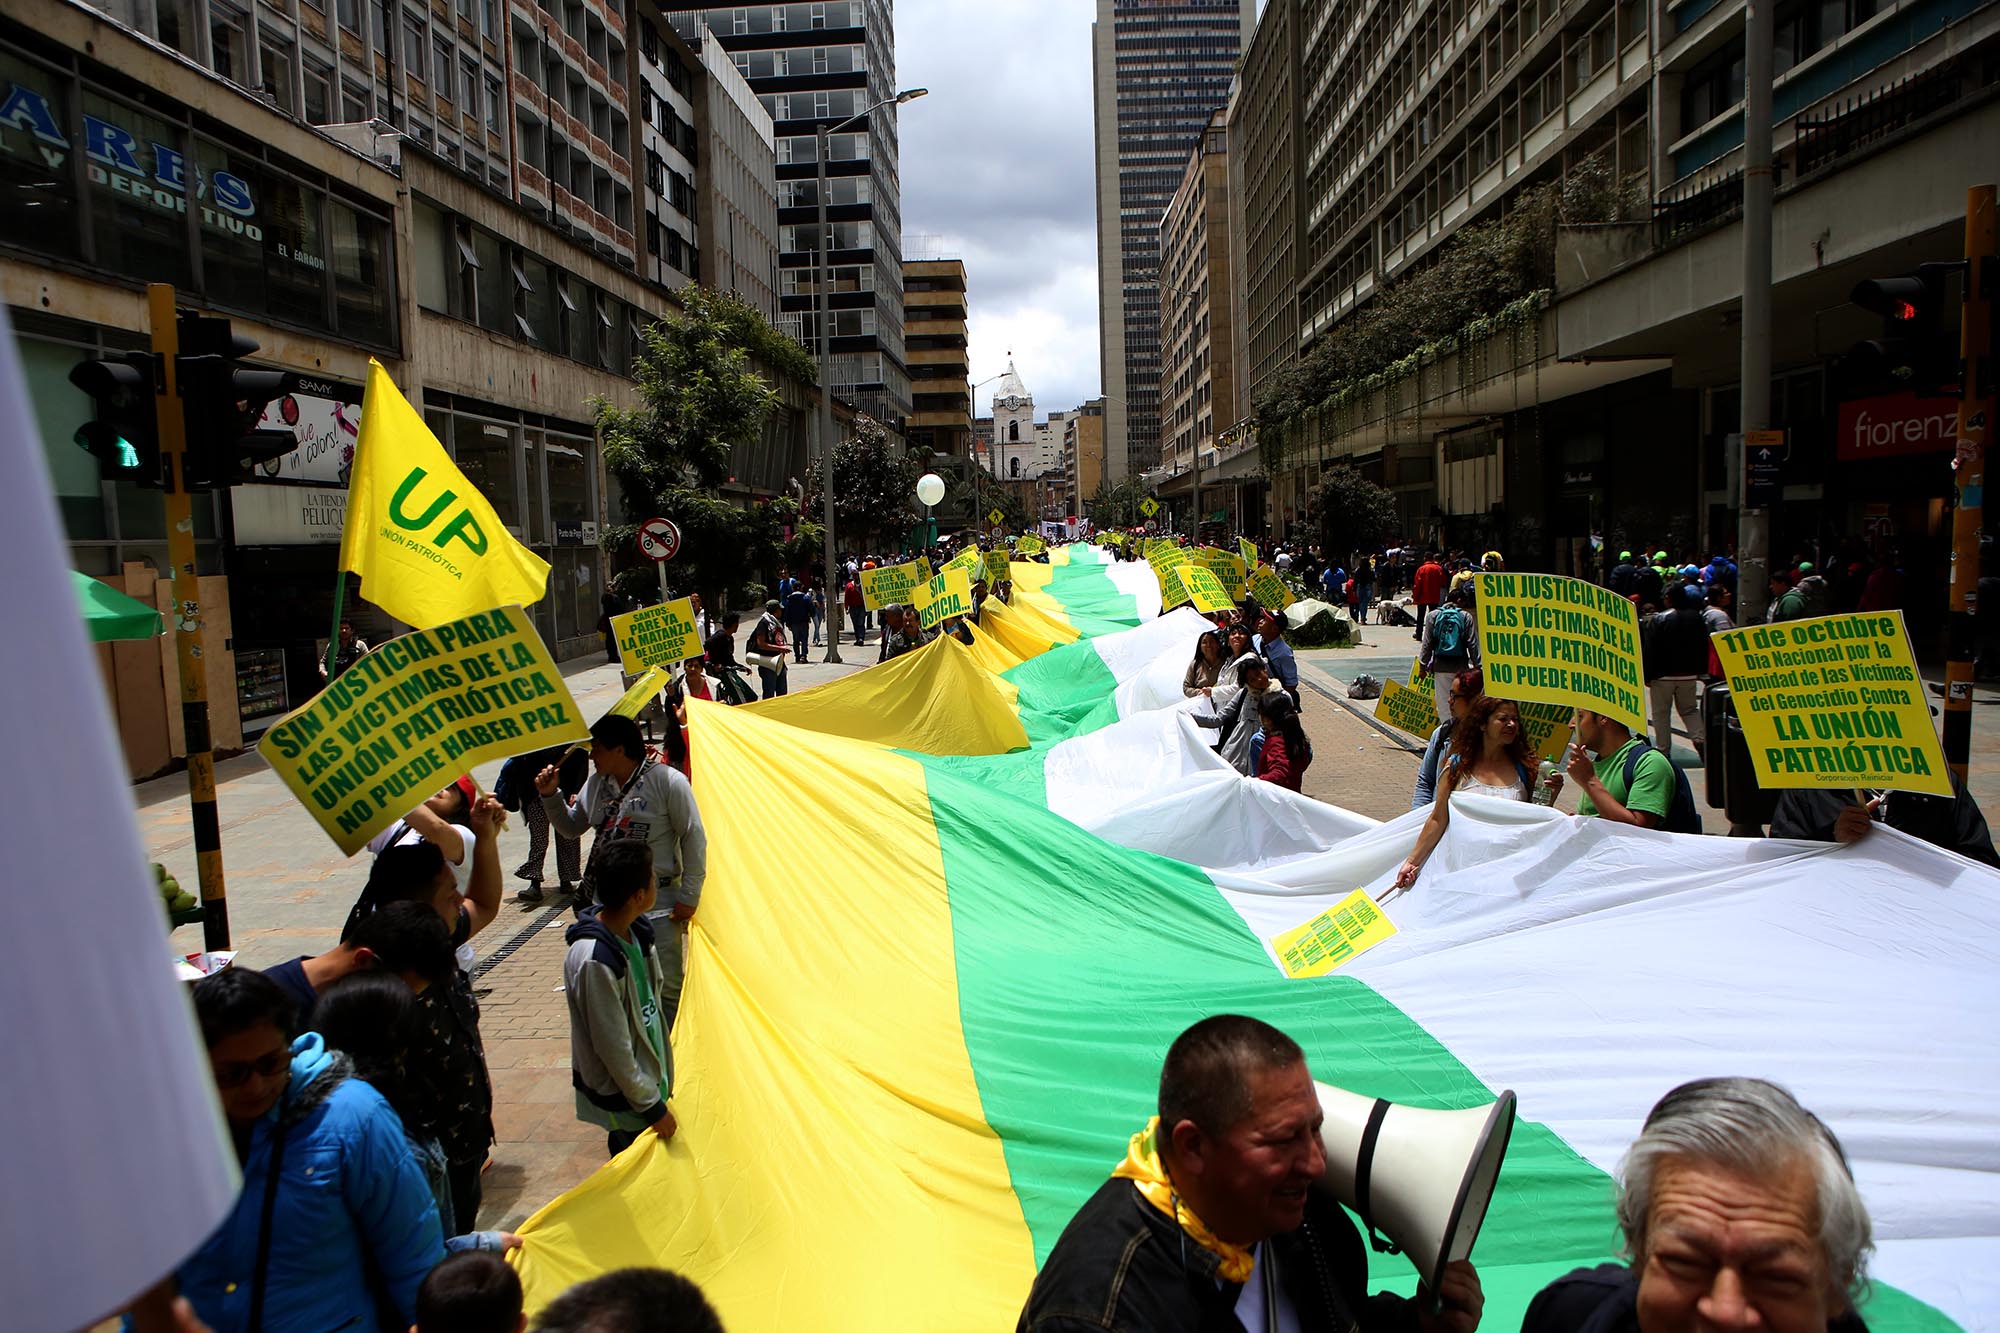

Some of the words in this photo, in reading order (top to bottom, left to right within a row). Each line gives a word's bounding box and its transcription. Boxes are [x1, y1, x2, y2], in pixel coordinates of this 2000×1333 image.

[278, 243, 289, 257] EL
[299, 379, 332, 394] SAMY
[1854, 411, 1957, 448] fiorenz
[289, 452, 300, 470] in
[306, 421, 340, 464] colors!
[307, 494, 319, 506] LA
[389, 466, 488, 557] UP
[380, 526, 405, 546] UNIÓN
[406, 540, 463, 580] PATRIÓTICA
[865, 586, 876, 594] LA
[878, 579, 916, 592] MATANZA
[872, 575, 894, 585] PARE
[896, 572, 906, 580] YA
[930, 574, 946, 598] SIN
[1188, 584, 1201, 594] LA
[1219, 576, 1243, 584] TANZA
[920, 594, 970, 628] USTICIA...
[1483, 574, 1516, 597] SIN
[1520, 575, 1595, 609] JUSTICIA
[1596, 588, 1631, 625] PARA
[629, 616, 661, 636] PARE
[662, 613, 679, 630] YA
[633, 607, 670, 622] SANTOS:
[621, 638, 637, 652] LA
[639, 621, 693, 648] MATANZA
[1485, 605, 1518, 627] LAS
[1521, 603, 1600, 640] VÍCTIMAS
[1602, 621, 1618, 648] DE
[1619, 629, 1635, 656] LA
[1721, 631, 1749, 653] 11
[1752, 627, 1787, 649] de
[1792, 616, 1895, 645] octubre
[635, 647, 648, 659] DE
[649, 636, 686, 655] LIDERES
[643, 648, 684, 667] SOCIALES
[1486, 630, 1546, 658] UNIÓN
[1550, 636, 1638, 687] PATRIÓTICA
[1774, 643, 1844, 666] Nacional
[1848, 645, 1870, 662] por
[1876, 641, 1892, 659] la
[269, 711, 325, 760] SIN
[321, 632, 440, 722] JUSTICIA
[433, 609, 517, 653] PARA
[1490, 663, 1513, 684] NO
[1516, 665, 1568, 690] PUEDE
[1571, 672, 1616, 705] HABER
[1618, 687, 1640, 717] PAZ
[1732, 671, 1799, 693] Dignidad
[1800, 669, 1819, 686] de
[1823, 665, 1849, 684] las
[1849, 663, 1914, 682] Víctimas
[1383, 696, 1426, 720] MATANZA
[1391, 693, 1422, 709] LIDERES
[1424, 706, 1434, 714] DE
[1750, 695, 1775, 712] del
[1778, 687, 1858, 710] Genocidio
[1861, 686, 1911, 706] Contra
[296, 735, 345, 785] LAS
[337, 663, 463, 745] VÍCTIMAS
[460, 652, 501, 682] DE
[499, 641, 537, 671] LA
[1389, 708, 1400, 719] YA
[1403, 714, 1428, 730] PARE
[1773, 715, 1809, 741] LA
[1810, 705, 1903, 739] UNIÓN
[311, 731, 396, 811] UNIÓN
[391, 670, 556, 750] PATRIÓTICA
[335, 801, 375, 836] NO
[368, 752, 446, 809] PUEDE
[440, 715, 520, 761] HABER
[520, 702, 571, 734] PAZ
[1765, 741, 1931, 777] PATRIÓTICA
[1329, 941, 1354, 963] LA
